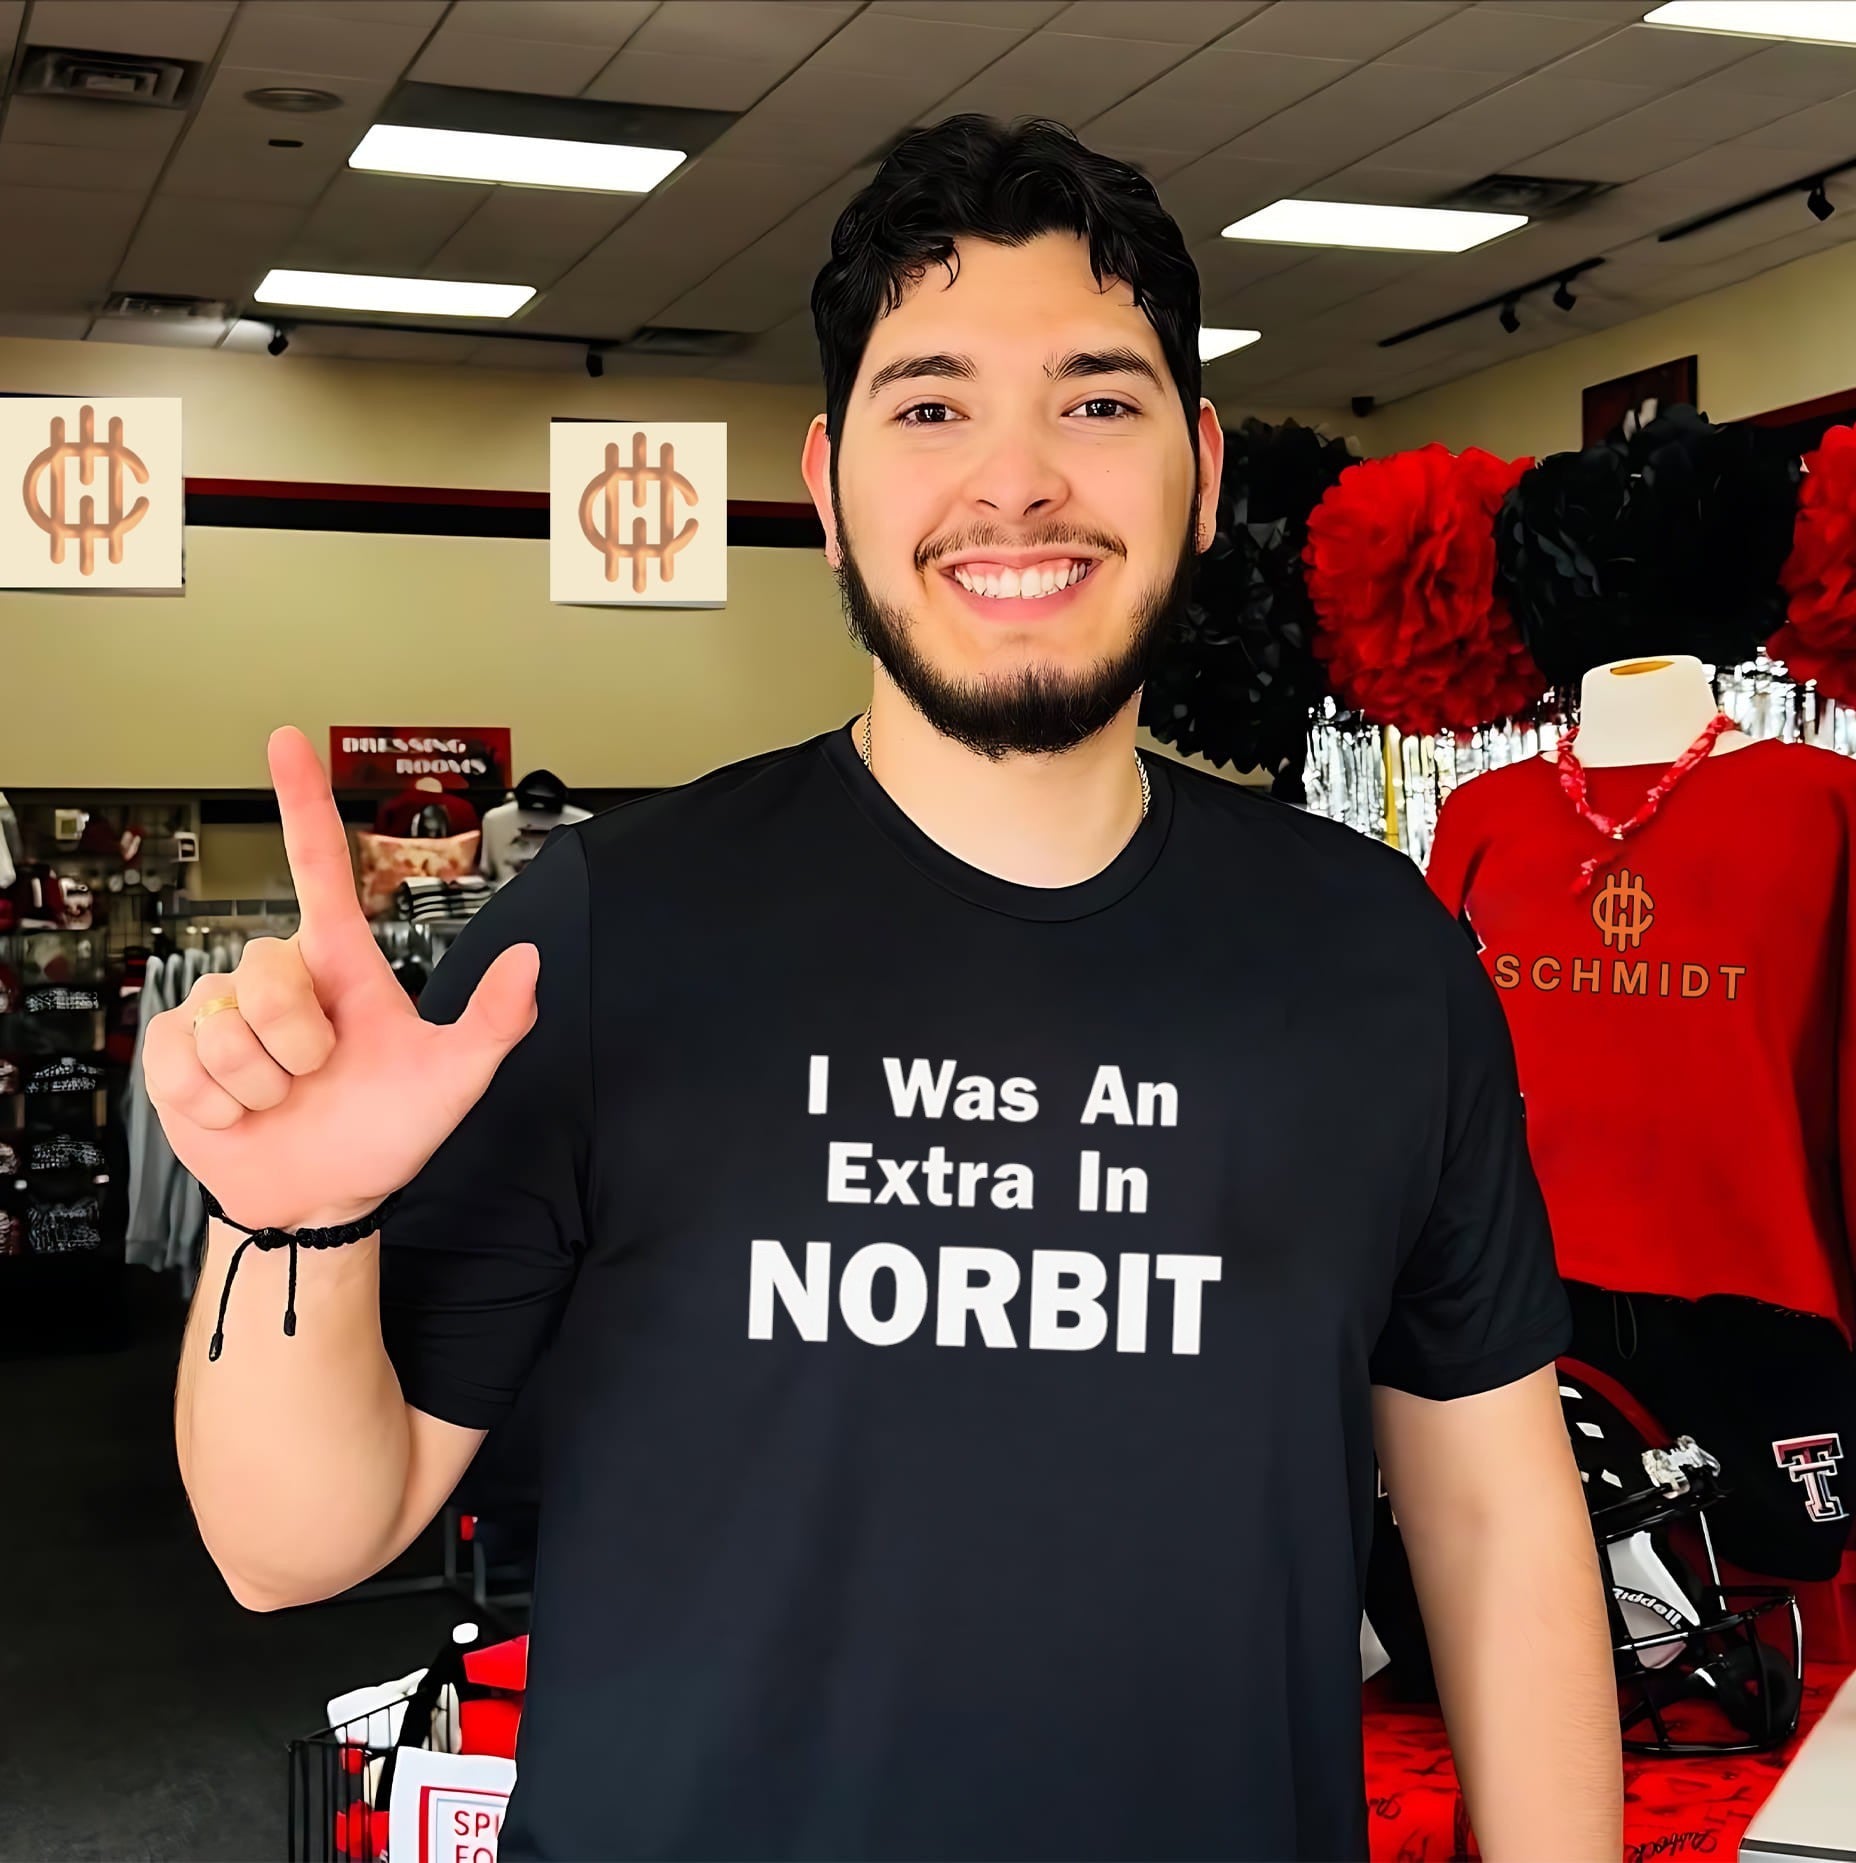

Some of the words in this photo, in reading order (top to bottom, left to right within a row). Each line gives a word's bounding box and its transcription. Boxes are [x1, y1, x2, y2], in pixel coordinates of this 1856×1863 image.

[395, 757, 487, 775] ROOMS
[1494, 953, 1747, 1001] SCHMIDT
[808, 1054, 829, 1115] I
[882, 1057, 1040, 1123] Was
[1080, 1064, 1179, 1127] An
[827, 1141, 1034, 1210] Extra
[1078, 1150, 1148, 1214] In
[747, 1239, 1223, 1356] NORBIT
